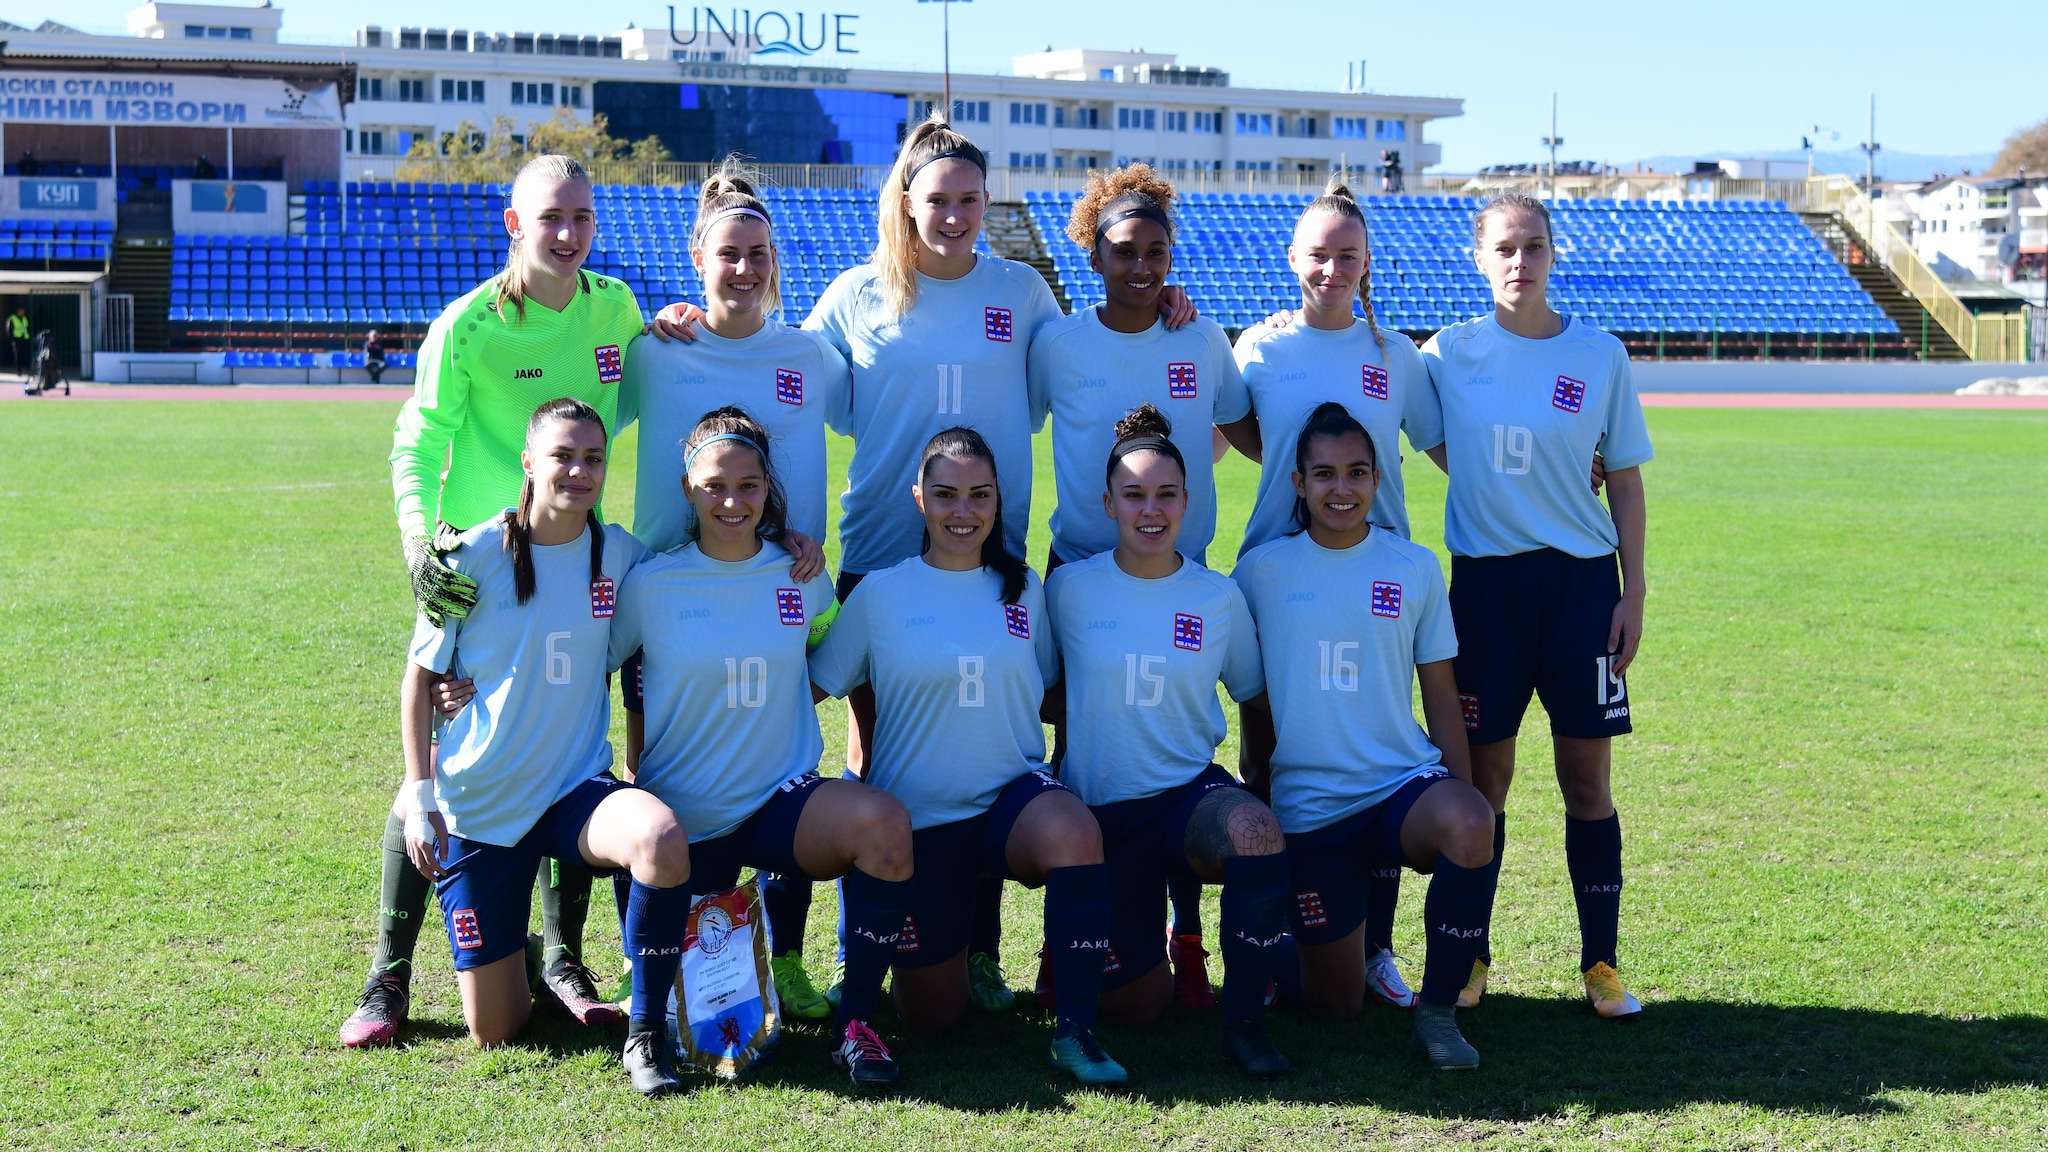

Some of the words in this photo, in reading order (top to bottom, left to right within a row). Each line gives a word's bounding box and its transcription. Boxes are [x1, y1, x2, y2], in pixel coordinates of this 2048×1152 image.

[667, 5, 860, 55] UNIQUE
[680, 64, 749, 79] resort
[759, 66, 799, 82] and
[809, 70, 848, 85] spa
[63, 79, 174, 97] СТАДИОН
[105, 100, 247, 123] ИЗВОРИ
[37, 184, 80, 202] КУП
[513, 368, 543, 379] JAKO
[673, 375, 705, 385] JAKO
[1464, 376, 1494, 385] JAKO
[936, 363, 961, 415] 11
[1077, 377, 1104, 389] JAKO
[1493, 423, 1533, 475] 19
[1285, 592, 1314, 602] JAKO
[679, 607, 711, 620] JAKO
[904, 616, 935, 629] JAKO
[1088, 620, 1117, 630] JAKO
[545, 631, 571, 685] 6
[1318, 640, 1359, 692] 16
[725, 656, 768, 709] 10
[958, 655, 985, 708] 8
[1125, 653, 1167, 707] 15
[1604, 706, 1629, 720] JAKO
[1584, 884, 1620, 893] JAKO
[853, 926, 899, 945] JAKO
[1236, 931, 1281, 947] JAKO
[1437, 923, 1482, 939] JAKO
[638, 946, 679, 956] JAKO
[1069, 939, 1109, 949] JAKO
